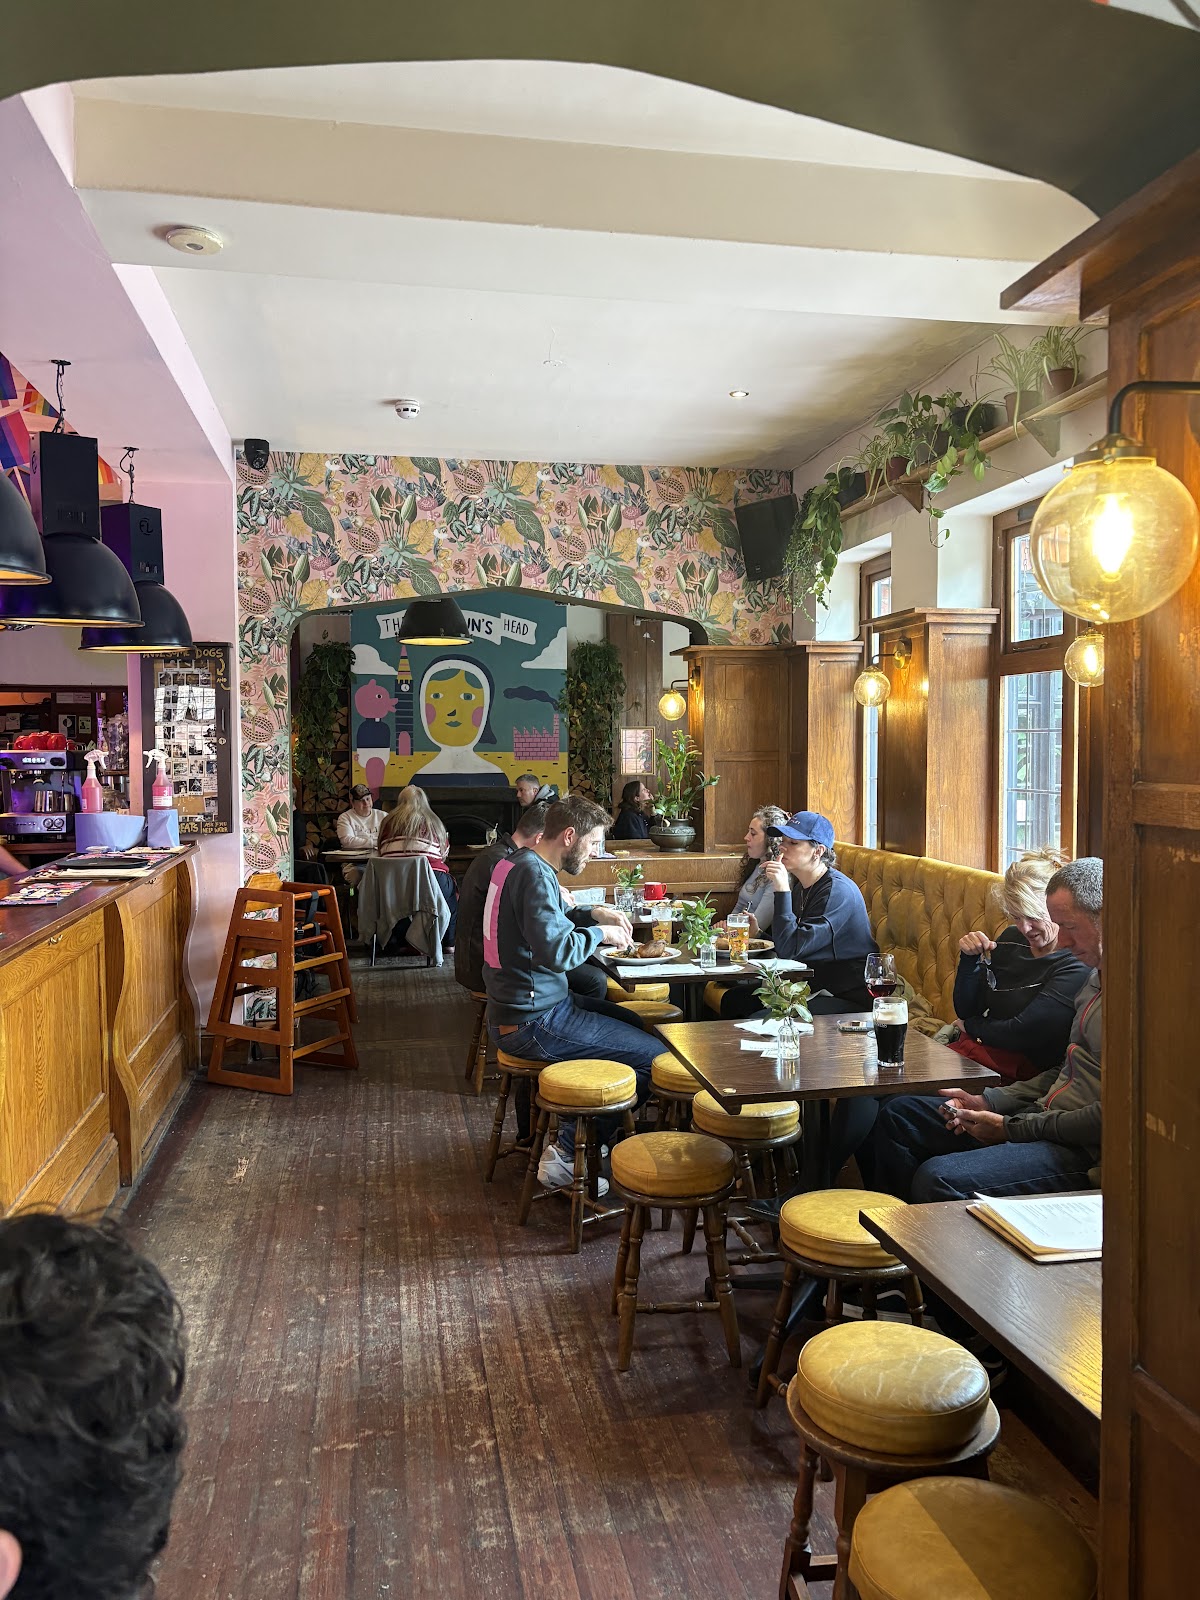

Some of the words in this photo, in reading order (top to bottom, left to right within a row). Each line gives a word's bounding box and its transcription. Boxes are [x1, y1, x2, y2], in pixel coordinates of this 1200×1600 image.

[382, 617, 403, 633] TH
[503, 618, 529, 636] HEAD
[195, 647, 224, 659] DOGS
